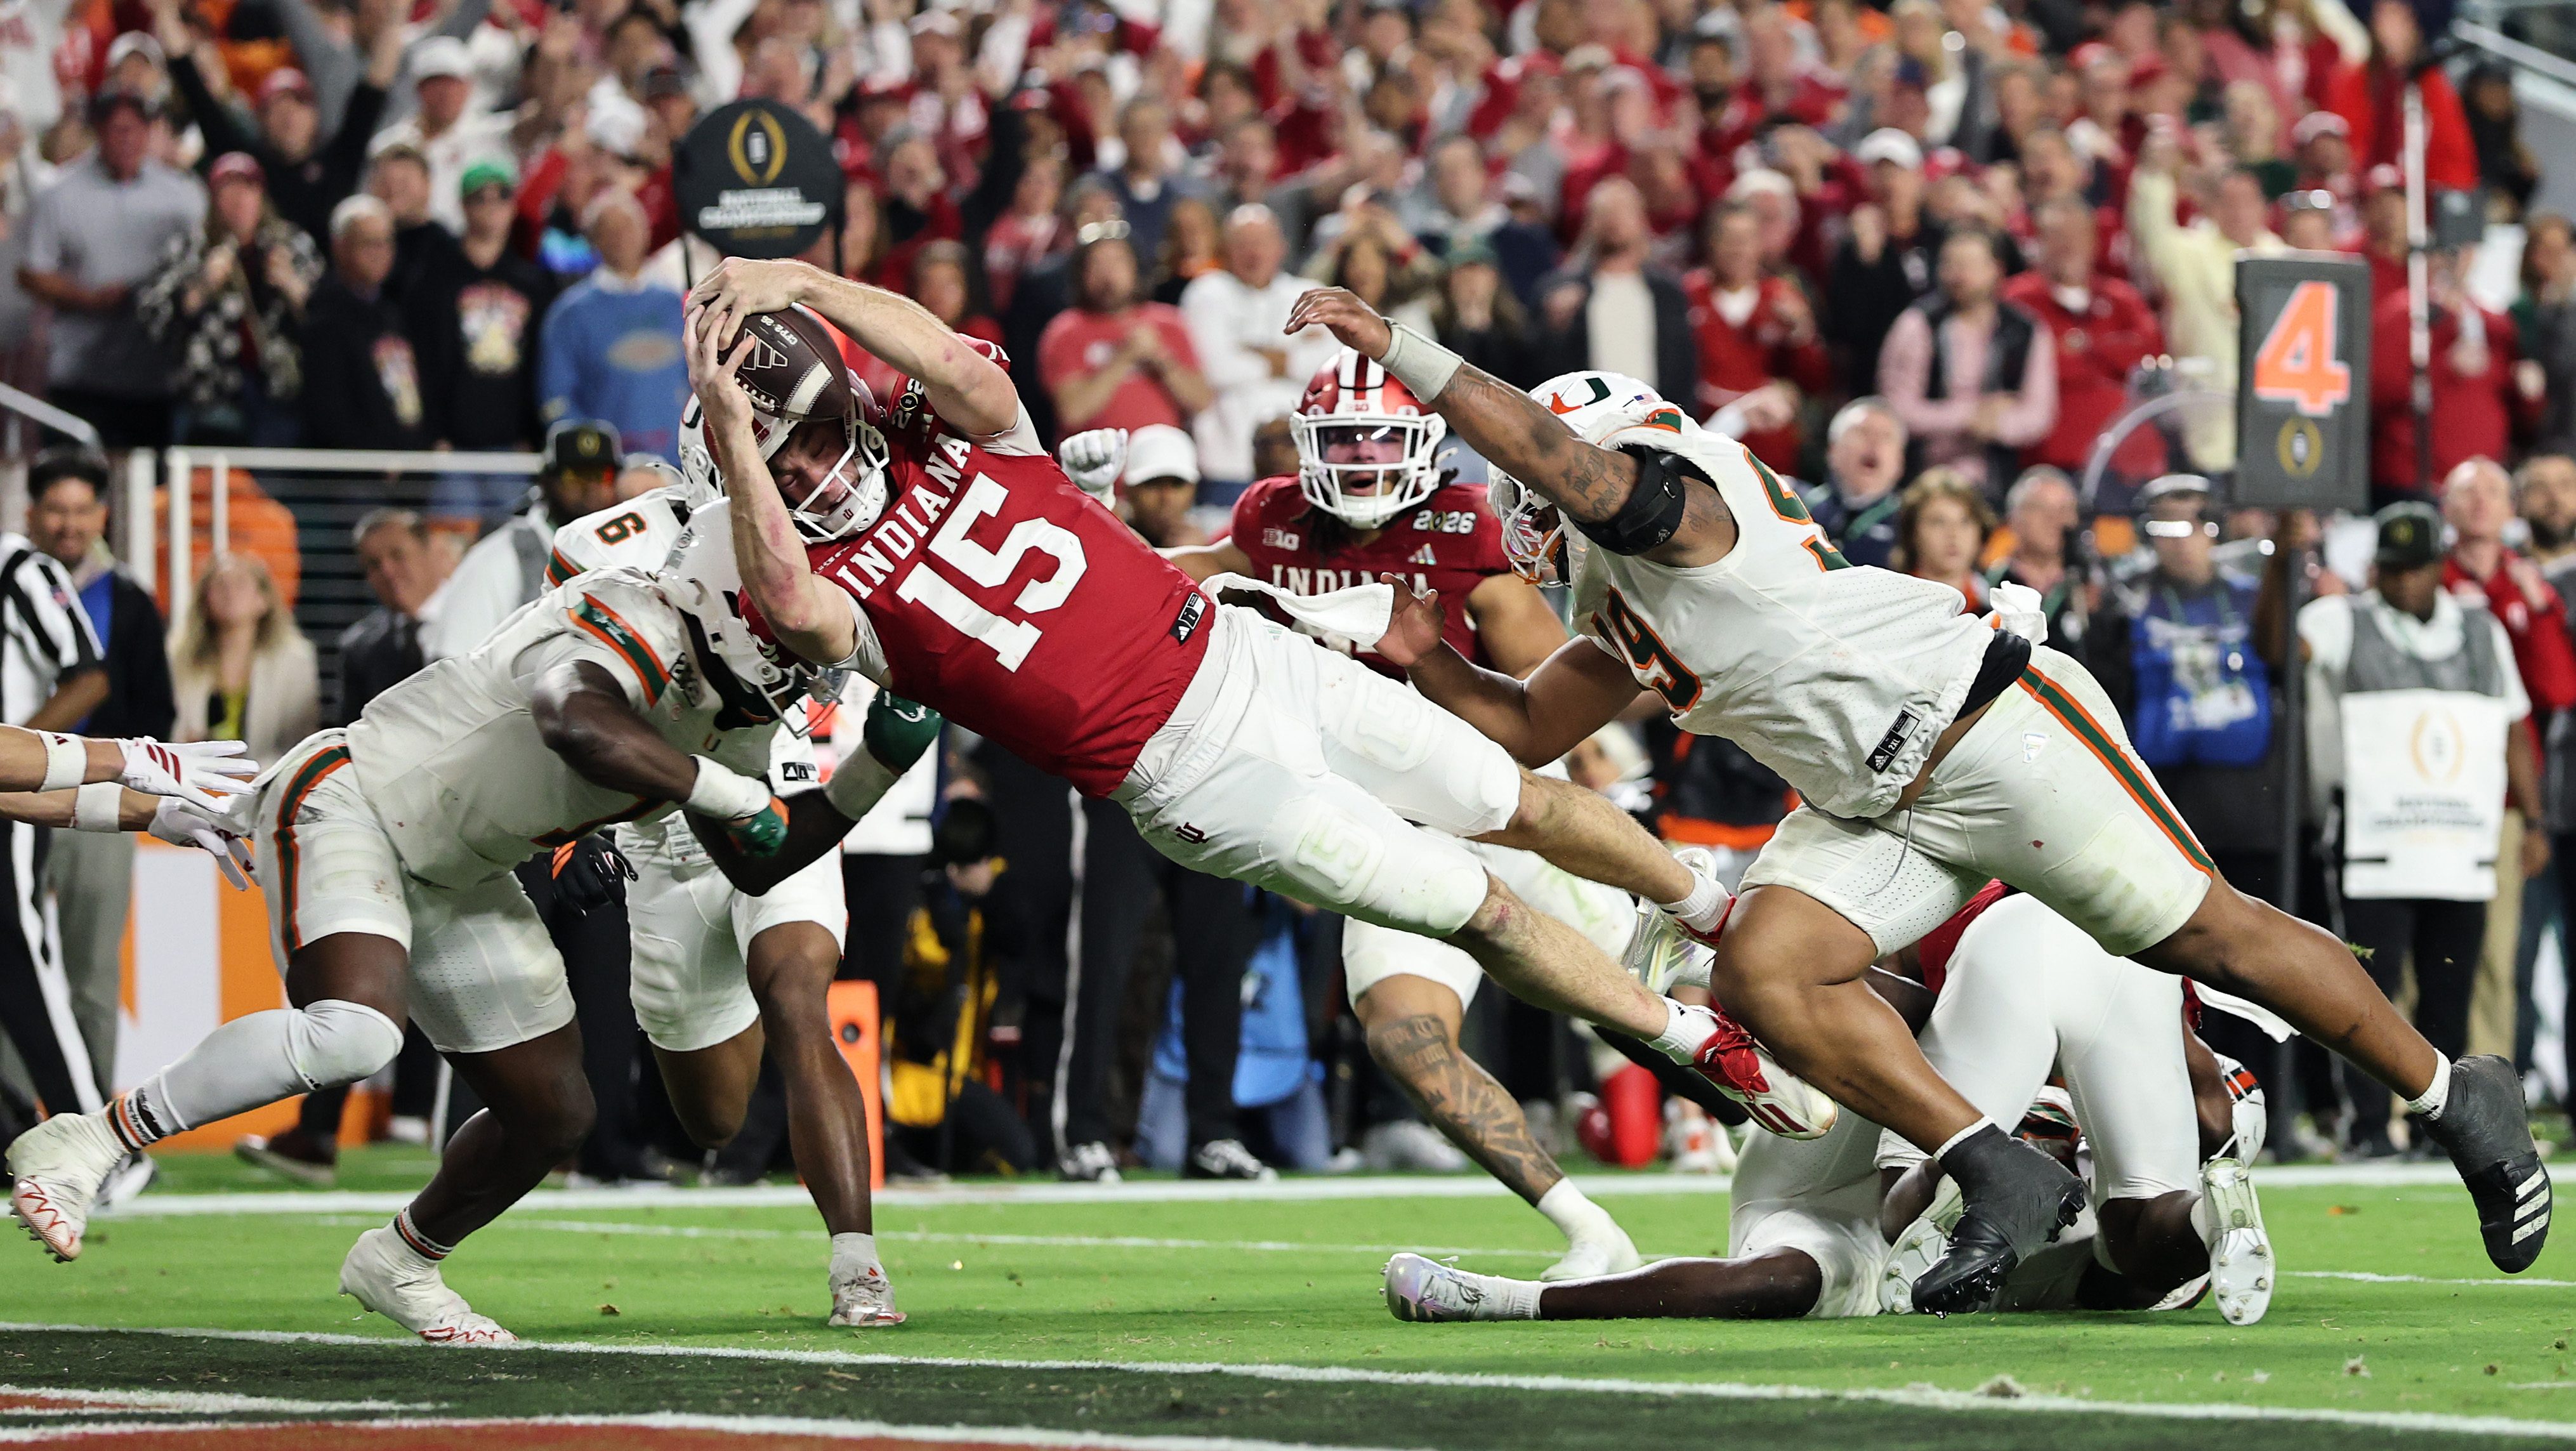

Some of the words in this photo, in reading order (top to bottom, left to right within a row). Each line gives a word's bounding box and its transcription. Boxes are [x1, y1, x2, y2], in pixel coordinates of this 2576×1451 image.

[2254, 280, 2350, 418] 4
[595, 511, 647, 546] 6
[836, 433, 971, 600] INDIANA
[1413, 509, 1477, 534] 2026
[896, 471, 1088, 673] 15
[1272, 564, 1429, 600] INDIA
[1877, 754, 1889, 770] adidas
[1888, 739, 1901, 751] 2XL
